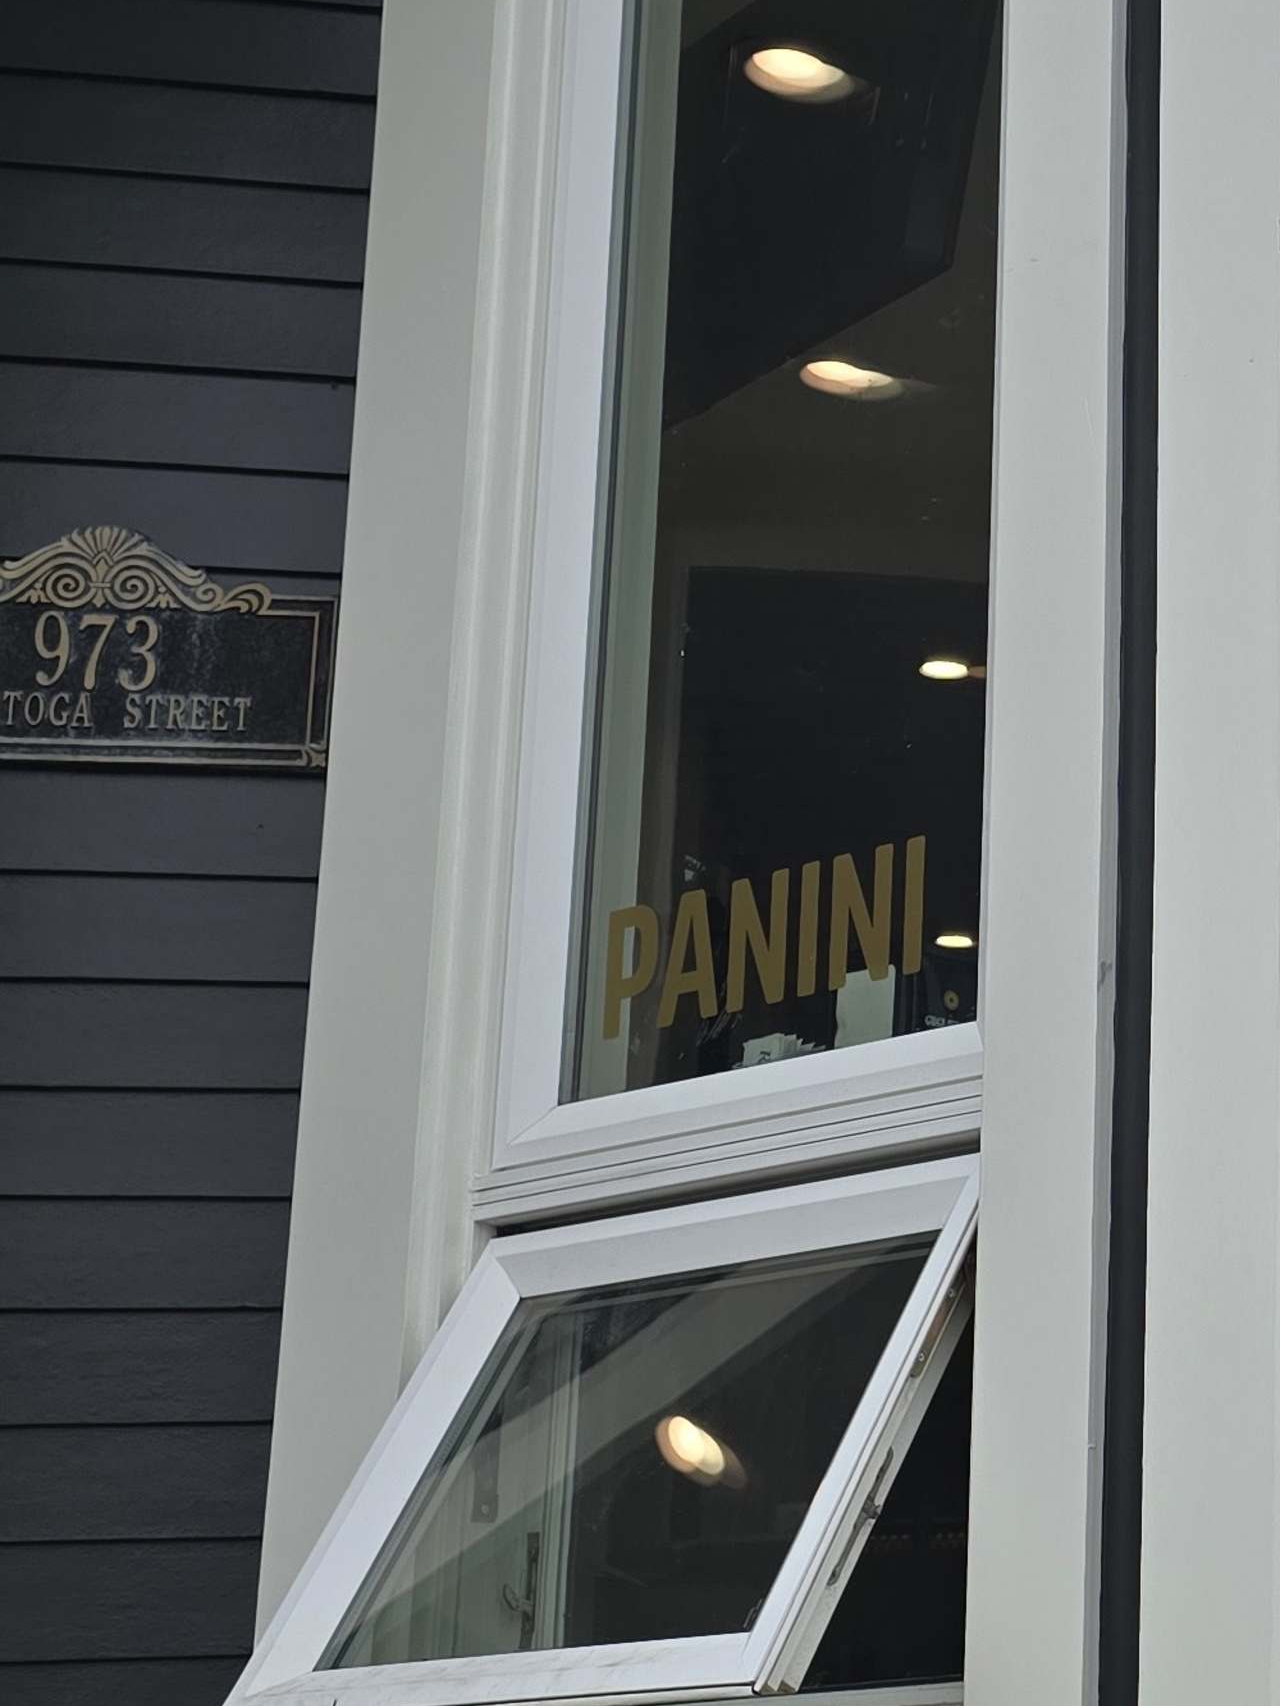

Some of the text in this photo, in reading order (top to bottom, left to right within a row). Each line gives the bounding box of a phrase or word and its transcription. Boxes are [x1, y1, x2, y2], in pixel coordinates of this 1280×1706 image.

[34, 610, 160, 692] 973
[123, 693, 253, 732] STREET
[603, 835, 927, 1040] PANINI
